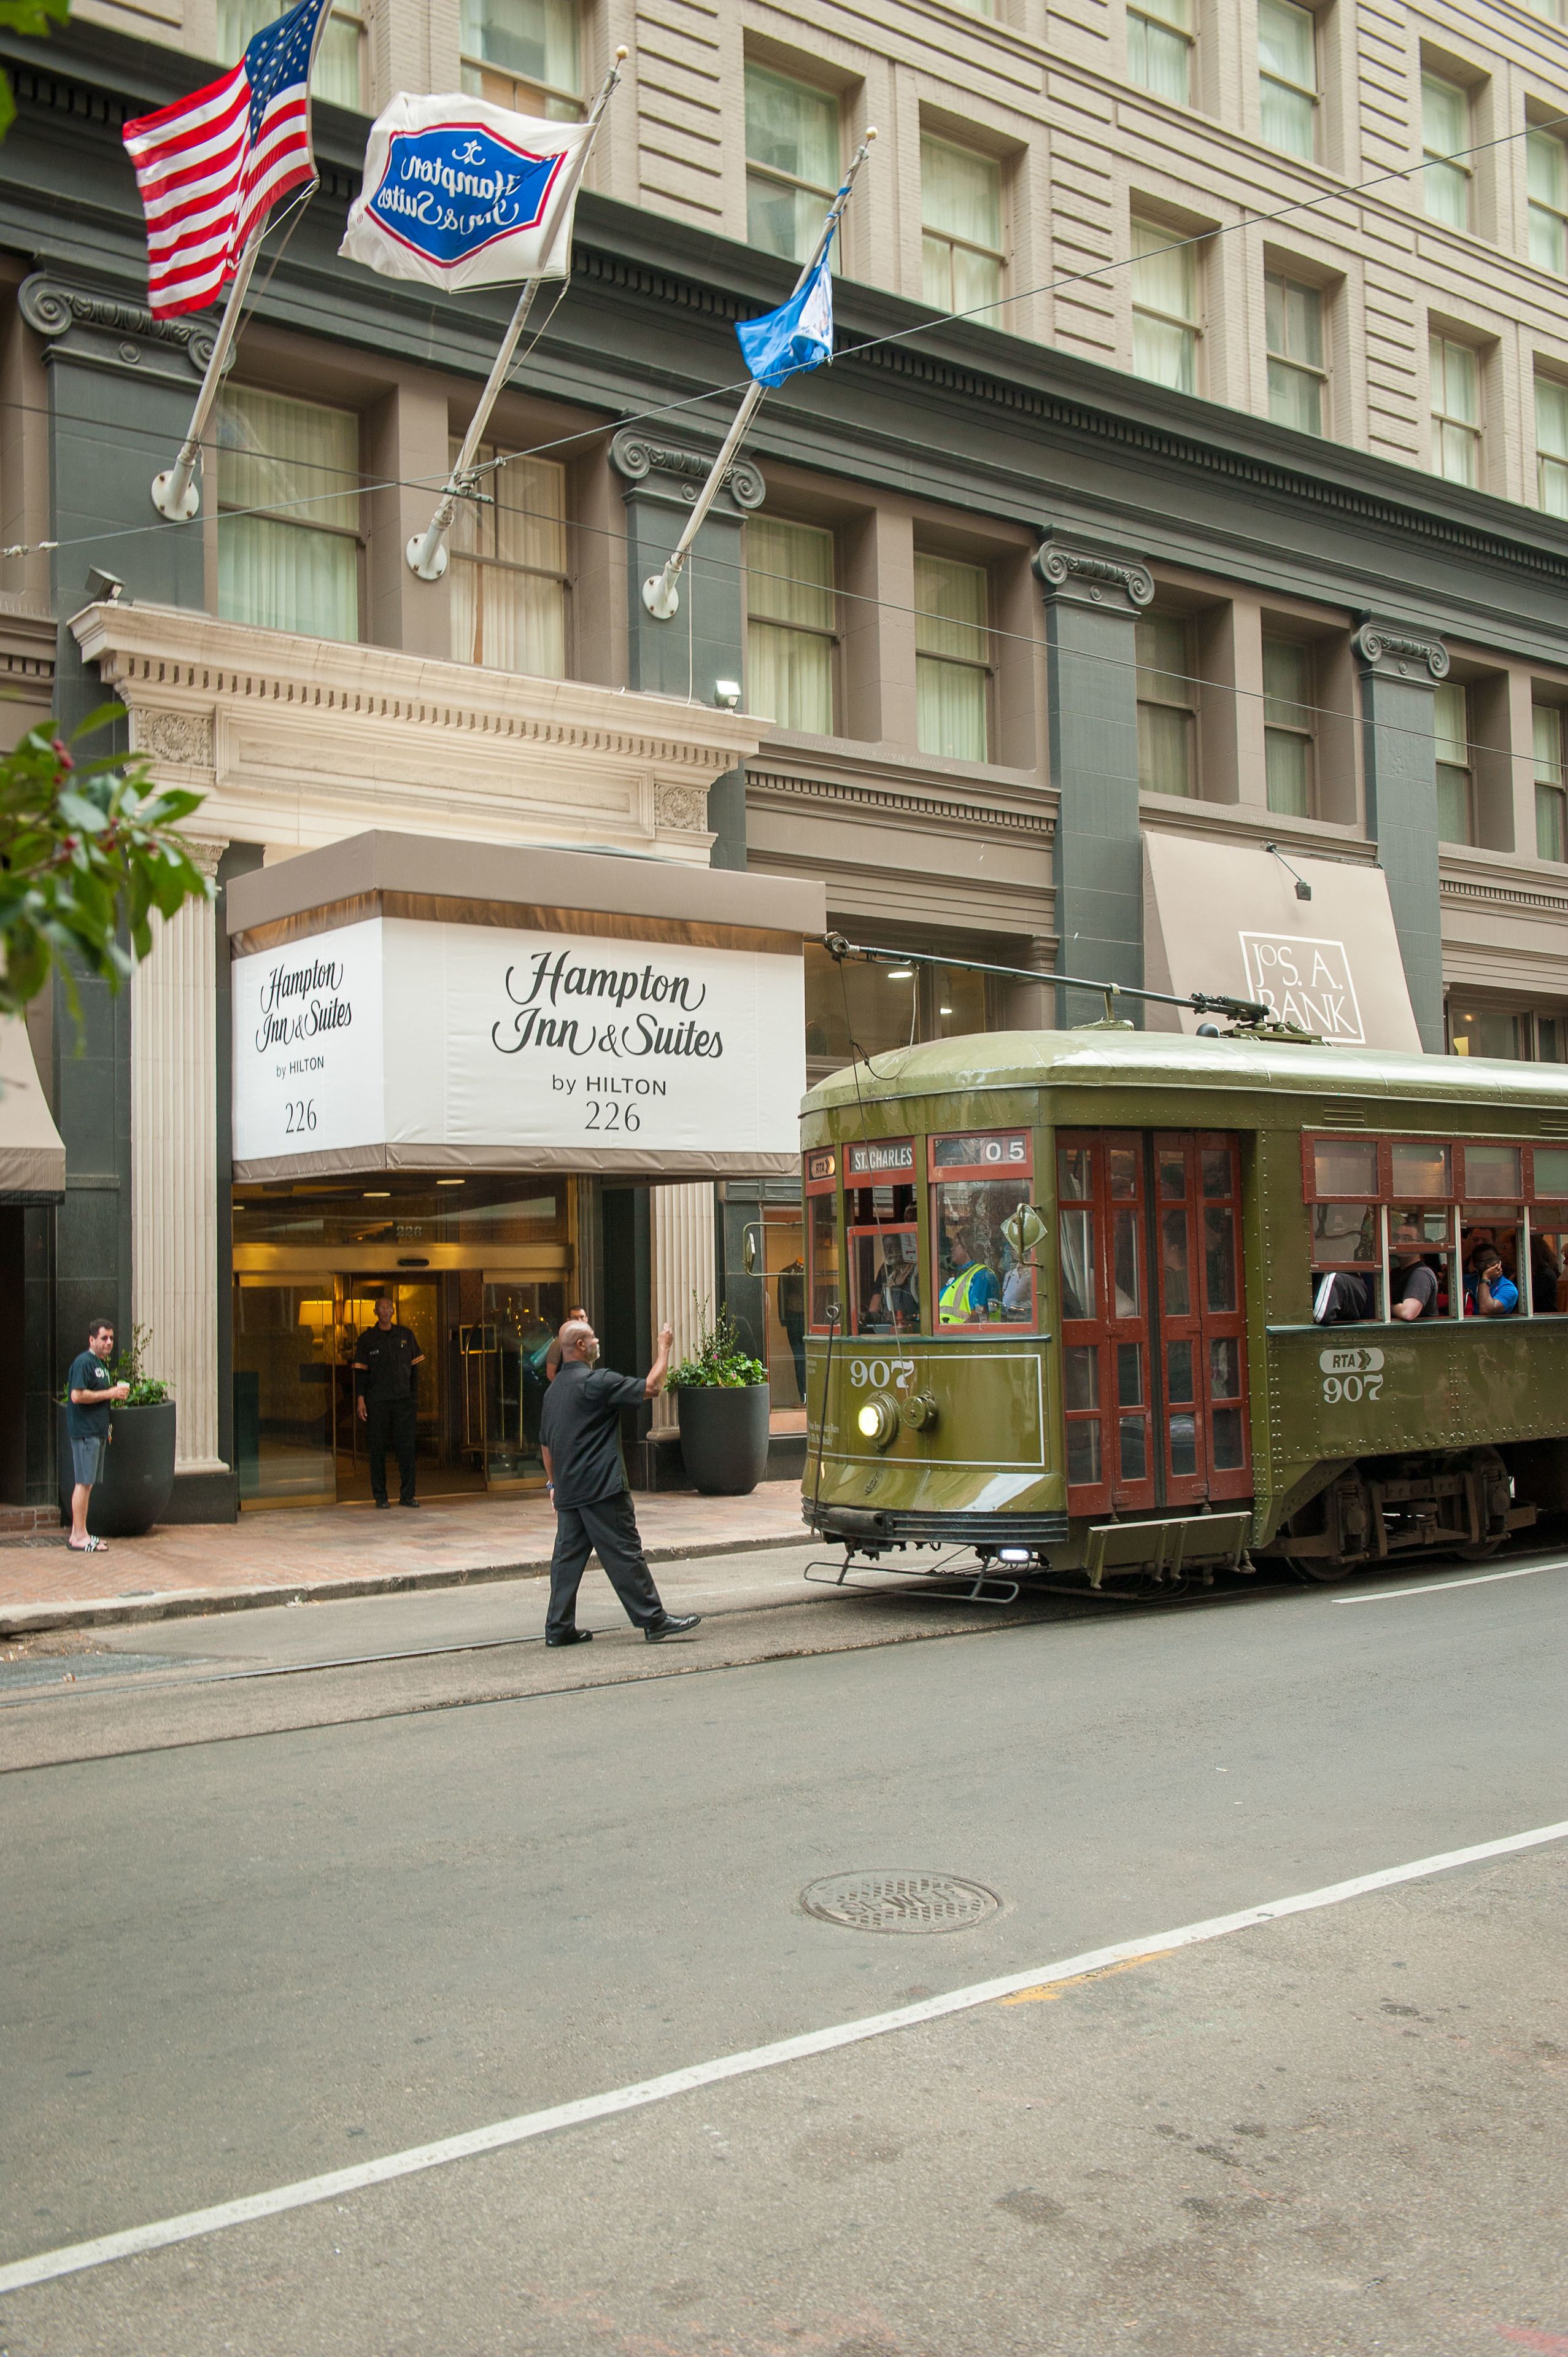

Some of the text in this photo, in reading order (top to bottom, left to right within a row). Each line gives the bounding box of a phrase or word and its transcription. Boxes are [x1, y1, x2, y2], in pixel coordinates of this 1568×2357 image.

[505, 950, 706, 1011] Hampton
[1311, 949, 1343, 989] A.
[260, 959, 344, 1013] Hampton
[255, 997, 352, 1052] Inn & Suites
[1256, 989, 1358, 1034] BANK
[492, 1007, 724, 1058] Inn & Suites
[276, 1056, 325, 1080] by HILTON
[552, 1075, 667, 1096] by HILTON
[285, 1099, 317, 1134] 226
[585, 1101, 641, 1132] 226
[816, 1161, 825, 1174] RTA
[855, 1147, 913, 1170] ST. CHARLES
[396, 1226, 422, 1237] 226
[850, 1360, 915, 1388] 907
[1332, 1354, 1355, 1368] RTA
[1323, 1374, 1384, 1404] 907
